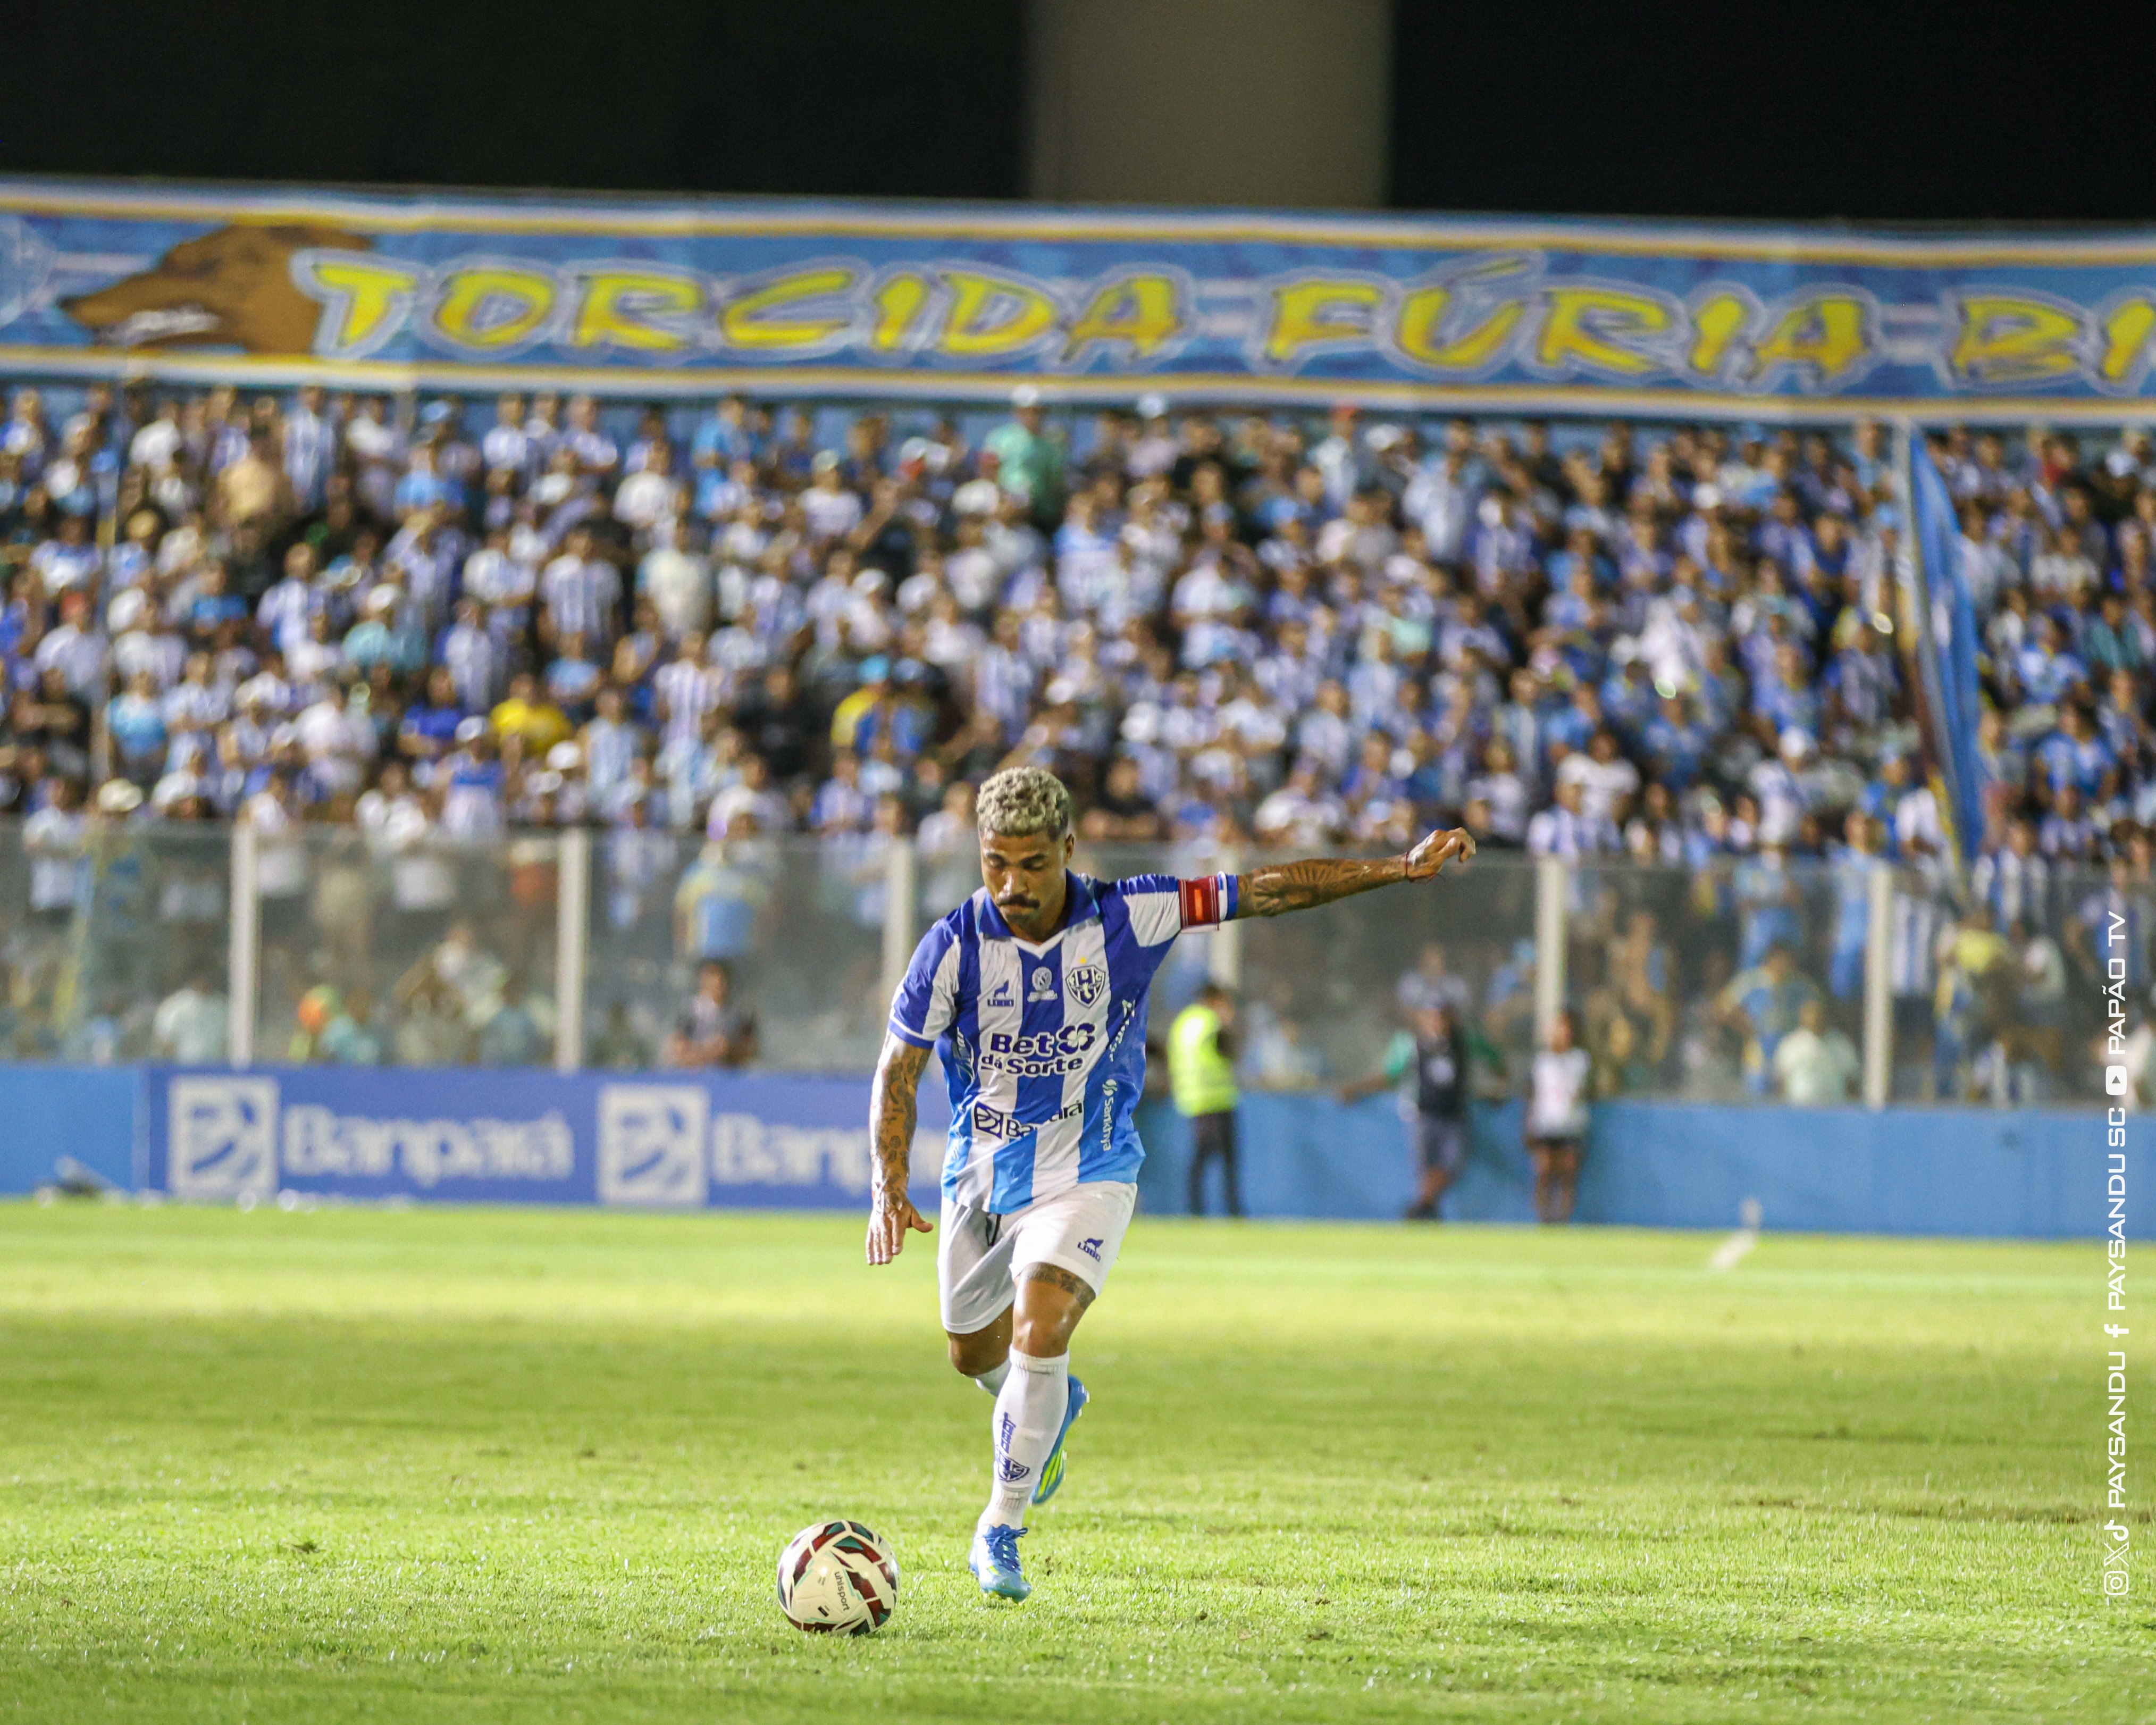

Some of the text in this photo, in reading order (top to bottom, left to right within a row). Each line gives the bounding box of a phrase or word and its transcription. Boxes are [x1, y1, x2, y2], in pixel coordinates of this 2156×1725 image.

[297, 253, 1187, 368] TORCIDA
[1256, 253, 1876, 386] FÚRIA
[990, 1032, 1053, 1054] Bet
[980, 1054, 1084, 1075] dá Sorte
[1100, 1096, 1114, 1151] Sankhya
[834, 1571, 850, 1611] uhlsport
